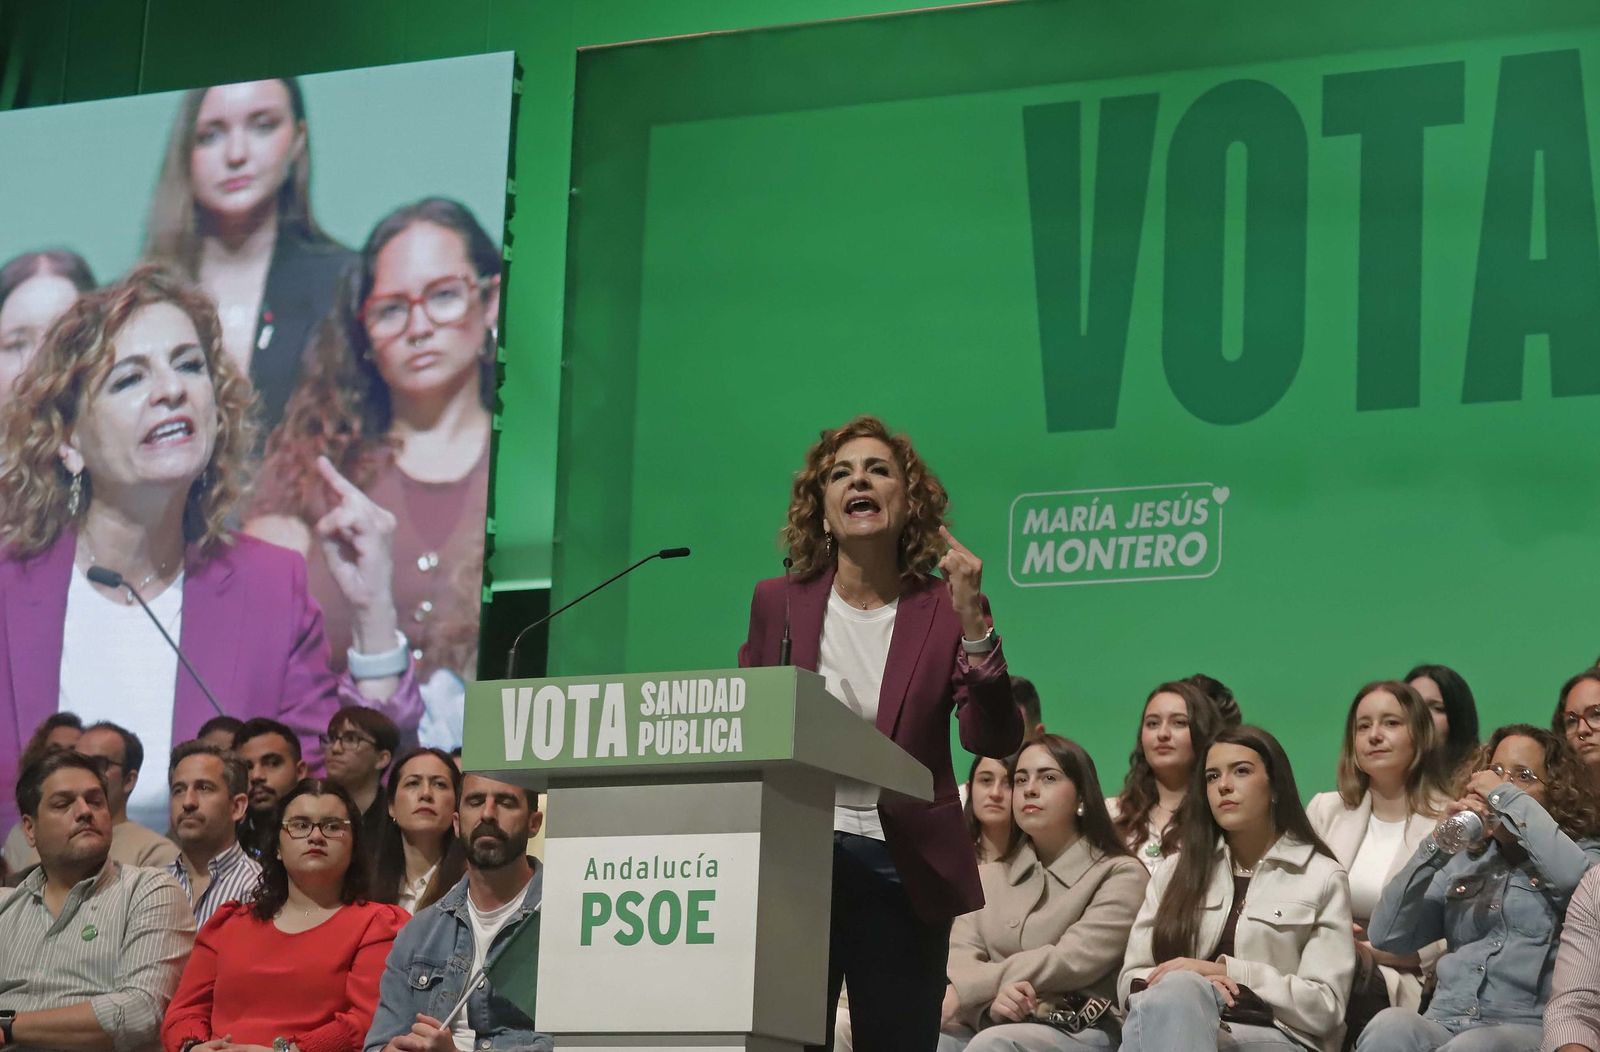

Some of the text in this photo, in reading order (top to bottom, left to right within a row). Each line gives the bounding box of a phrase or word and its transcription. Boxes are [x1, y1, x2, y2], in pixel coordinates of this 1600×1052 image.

[1022, 48, 1600, 433] VOTA
[1022, 491, 1209, 534] MARÍA JESÚS
[1021, 532, 1208, 574] MONTERO
[640, 677, 746, 716] SANIDAD
[501, 683, 628, 761] VOTA
[638, 715, 743, 756] PÚBLICA
[584, 853, 719, 881] Andalucía
[580, 889, 716, 946] PSOE
